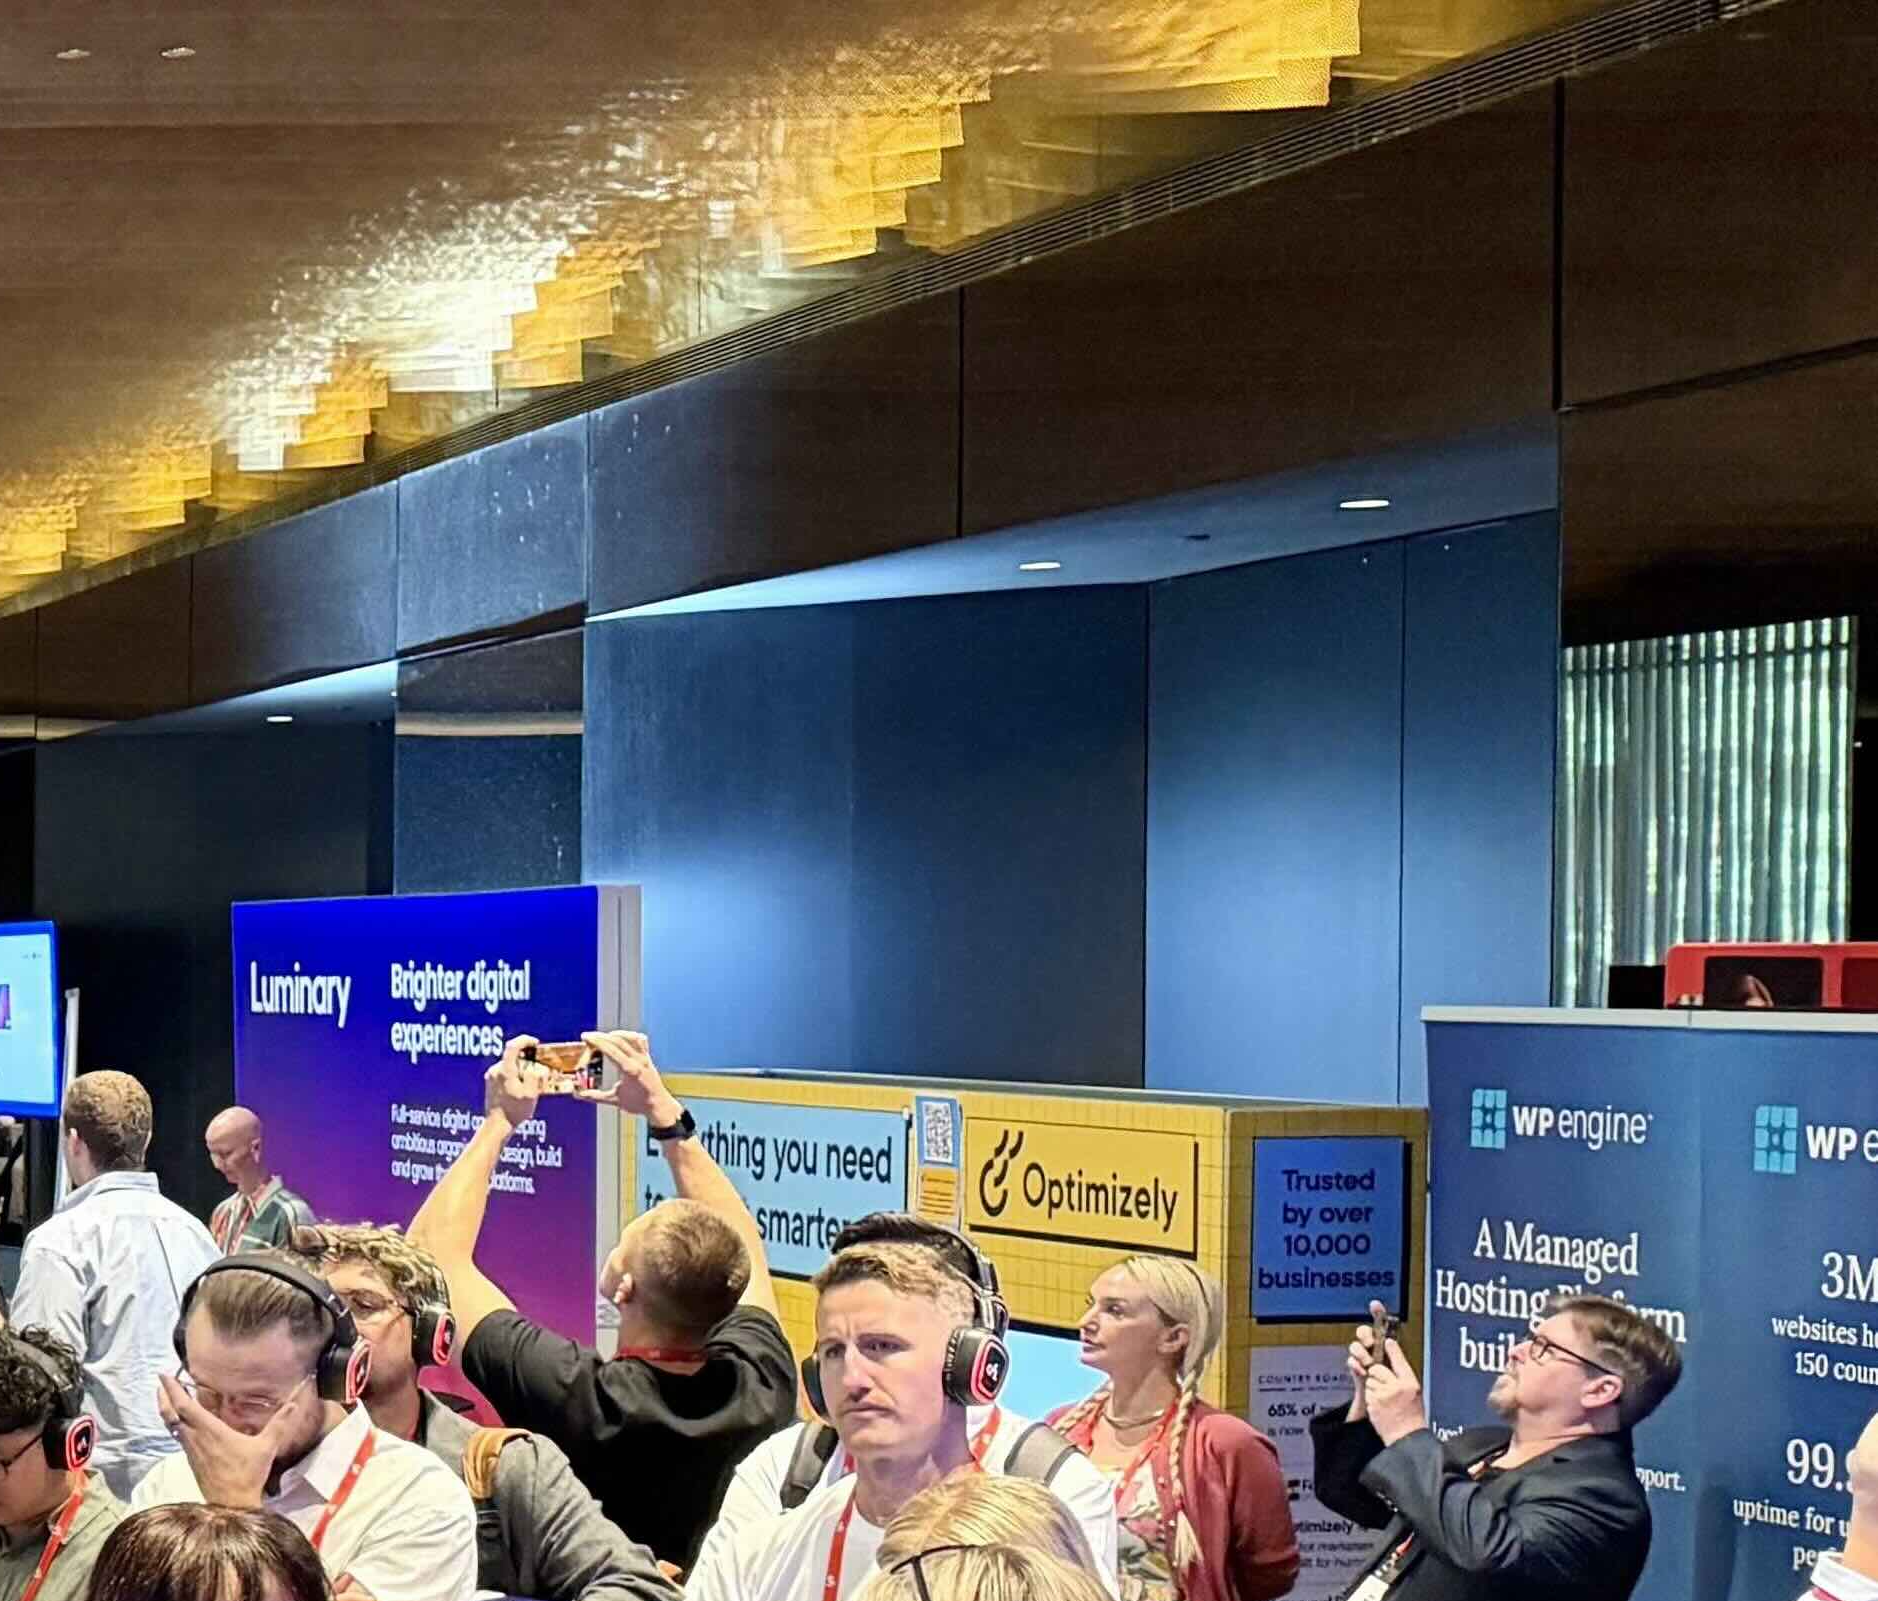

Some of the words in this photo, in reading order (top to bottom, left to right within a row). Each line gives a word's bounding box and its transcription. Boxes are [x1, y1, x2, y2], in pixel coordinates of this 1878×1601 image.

[250, 961, 351, 1028] Luminary
[391, 960, 464, 1012] Brighter
[466, 959, 531, 1014] digital
[391, 1014, 504, 1064] experiences
[773, 1134, 818, 1183] you
[826, 1136, 892, 1185] need
[1280, 1168, 1376, 1193] Trusted
[1022, 1161, 1179, 1233] Optimizely
[1282, 1201, 1312, 1226] by
[1319, 1206, 1375, 1224] over
[1283, 1234, 1371, 1258] 10,000
[1473, 1218, 1495, 1259] A
[1503, 1220, 1640, 1284] Managed
[1257, 1266, 1395, 1290] businesses
[1436, 1268, 1550, 1333] Hosting
[1771, 1314, 1857, 1347] websites
[1794, 1350, 1829, 1379] 150
[1267, 1402, 1298, 1418] 65%
[1733, 1496, 1800, 1530] uptime
[1804, 1507, 1835, 1539] for
